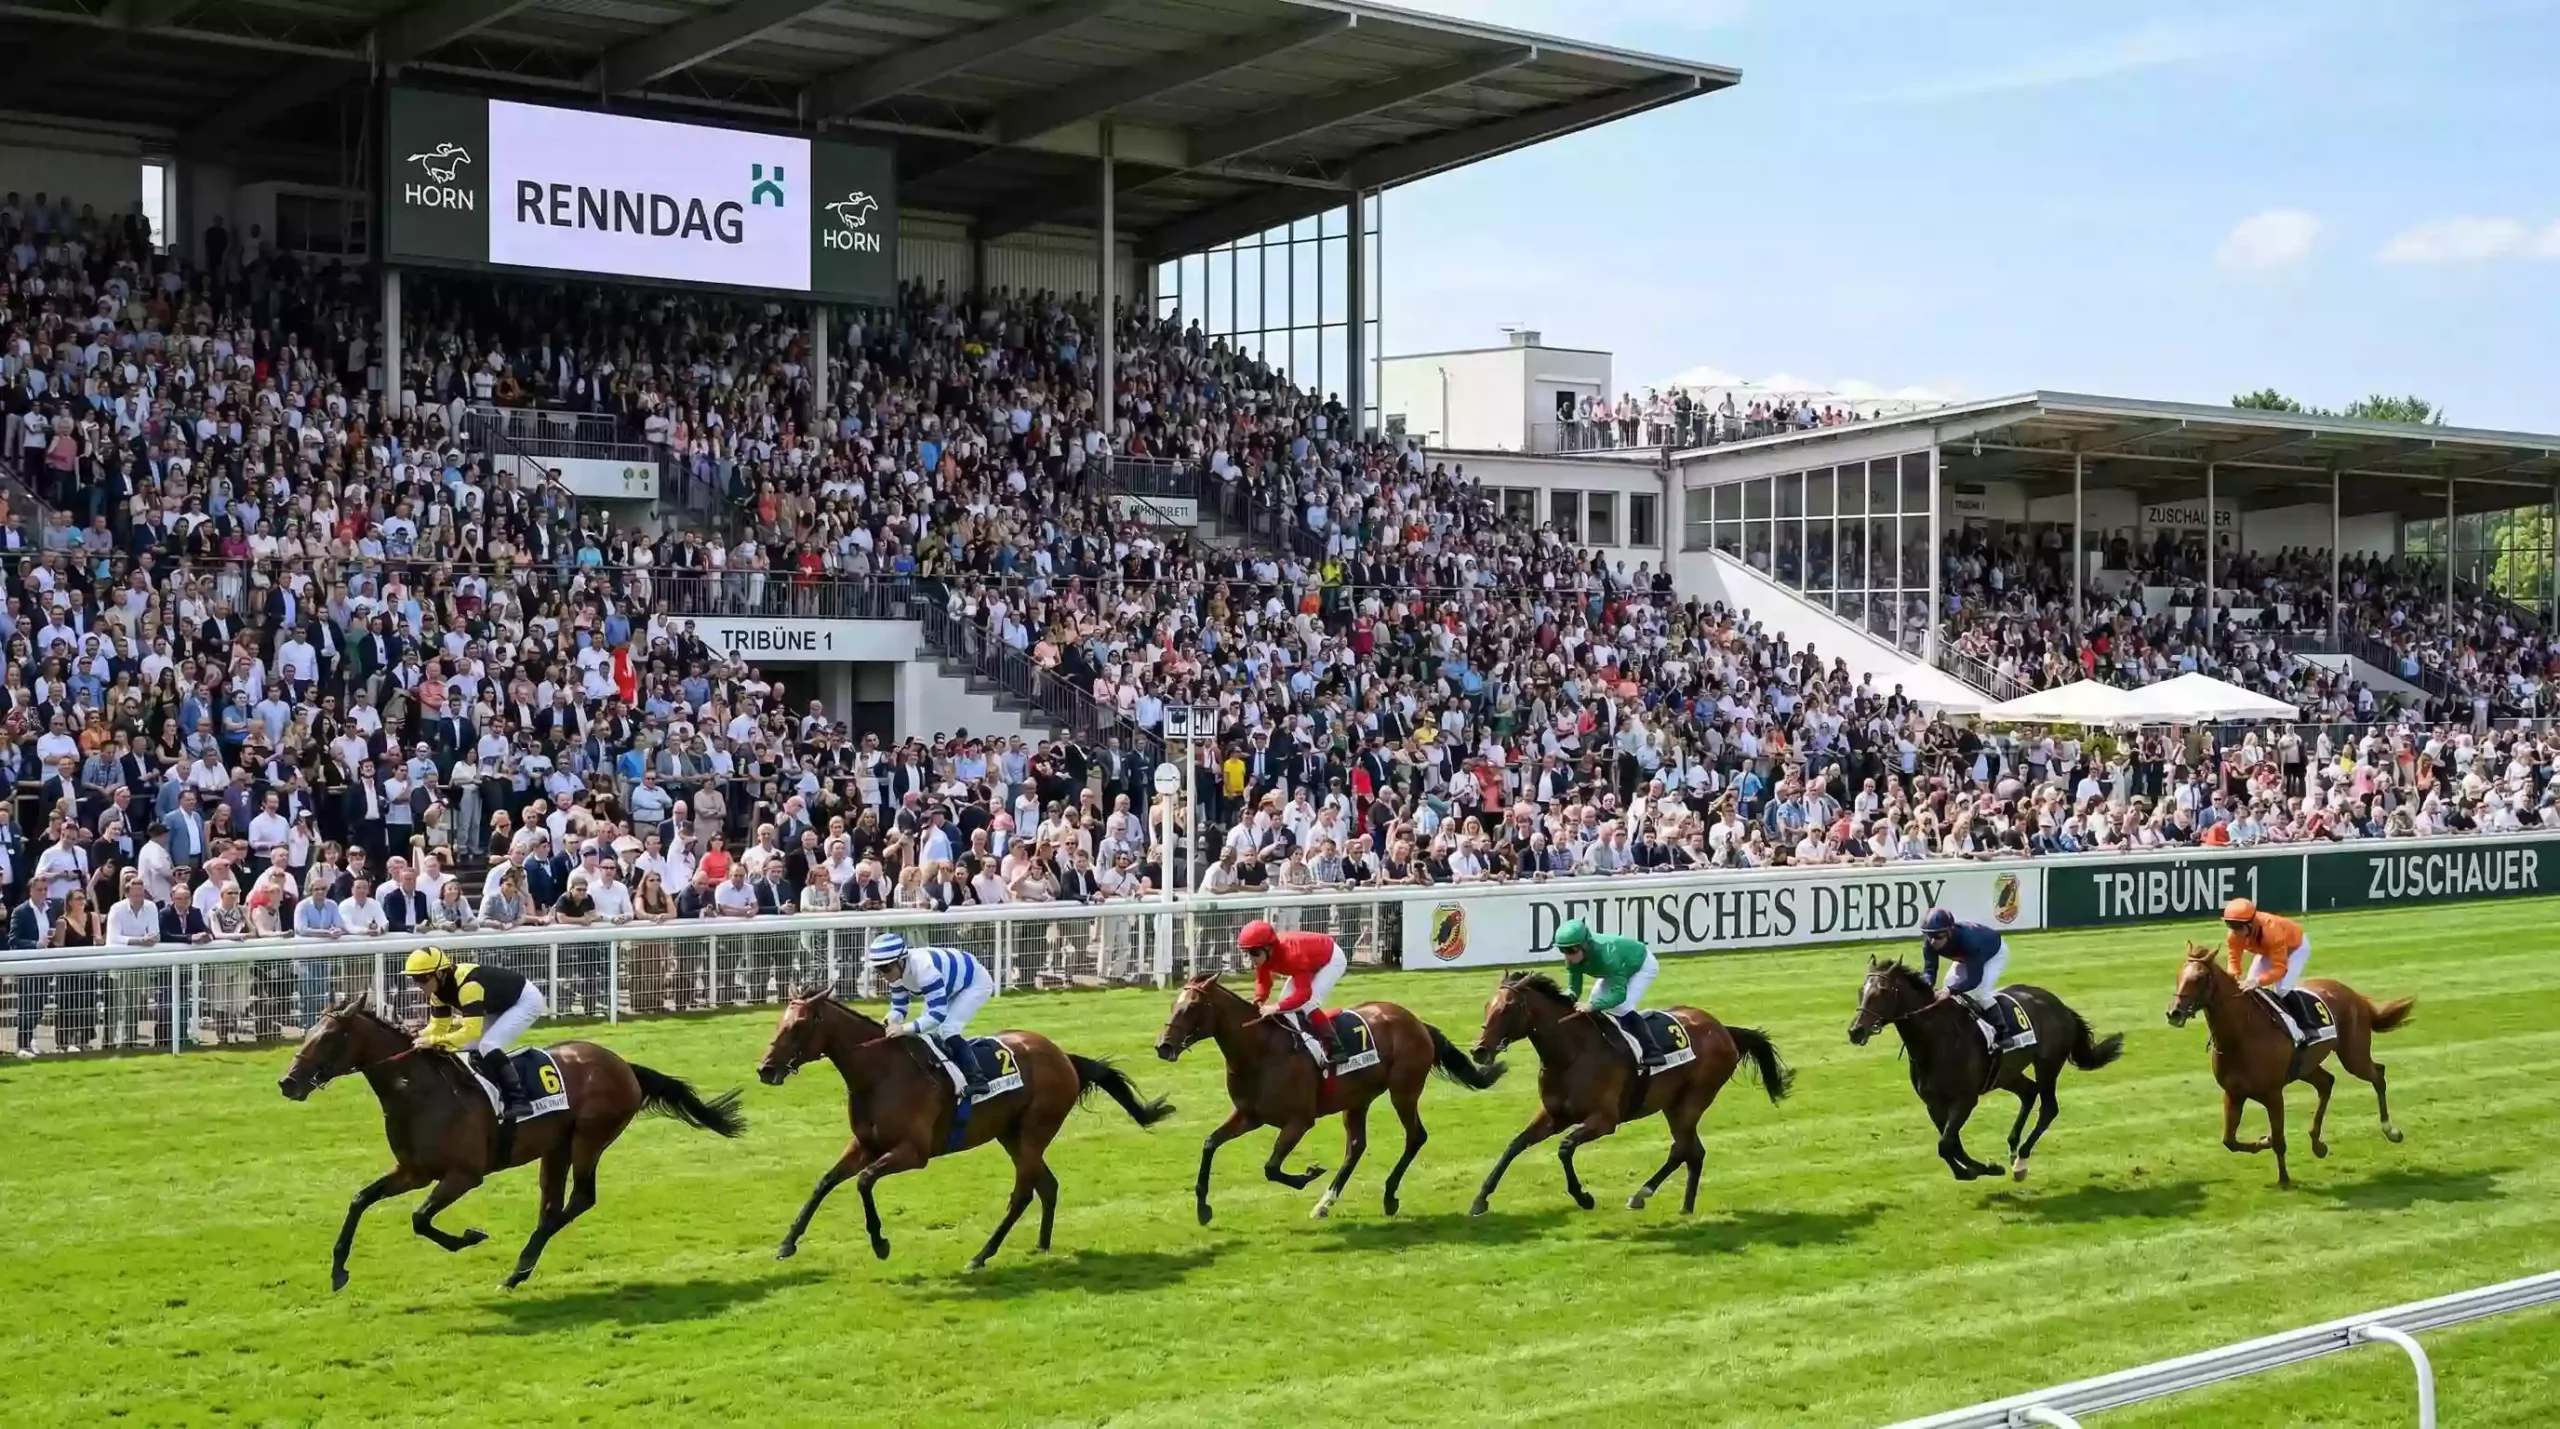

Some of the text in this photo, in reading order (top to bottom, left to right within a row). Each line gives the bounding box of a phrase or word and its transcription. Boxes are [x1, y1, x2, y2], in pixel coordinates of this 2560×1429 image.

[405, 183, 474, 211] HORN
[517, 179, 743, 244] RENNDAG
[823, 228, 880, 253] HORN
[2148, 507, 2231, 526] ZUSCHAUER
[721, 626, 832, 651] TRIBÜNE 1
[2368, 849, 2538, 899] ZUSCHAUER
[2093, 860, 2258, 917] TRIBÜNE 1
[1810, 879, 1946, 934] DERBY
[1352, 1025, 1367, 1051] 7
[1667, 1025, 1687, 1048] 3
[995, 1049, 1016, 1075] 2
[538, 1064, 560, 1094] 6
